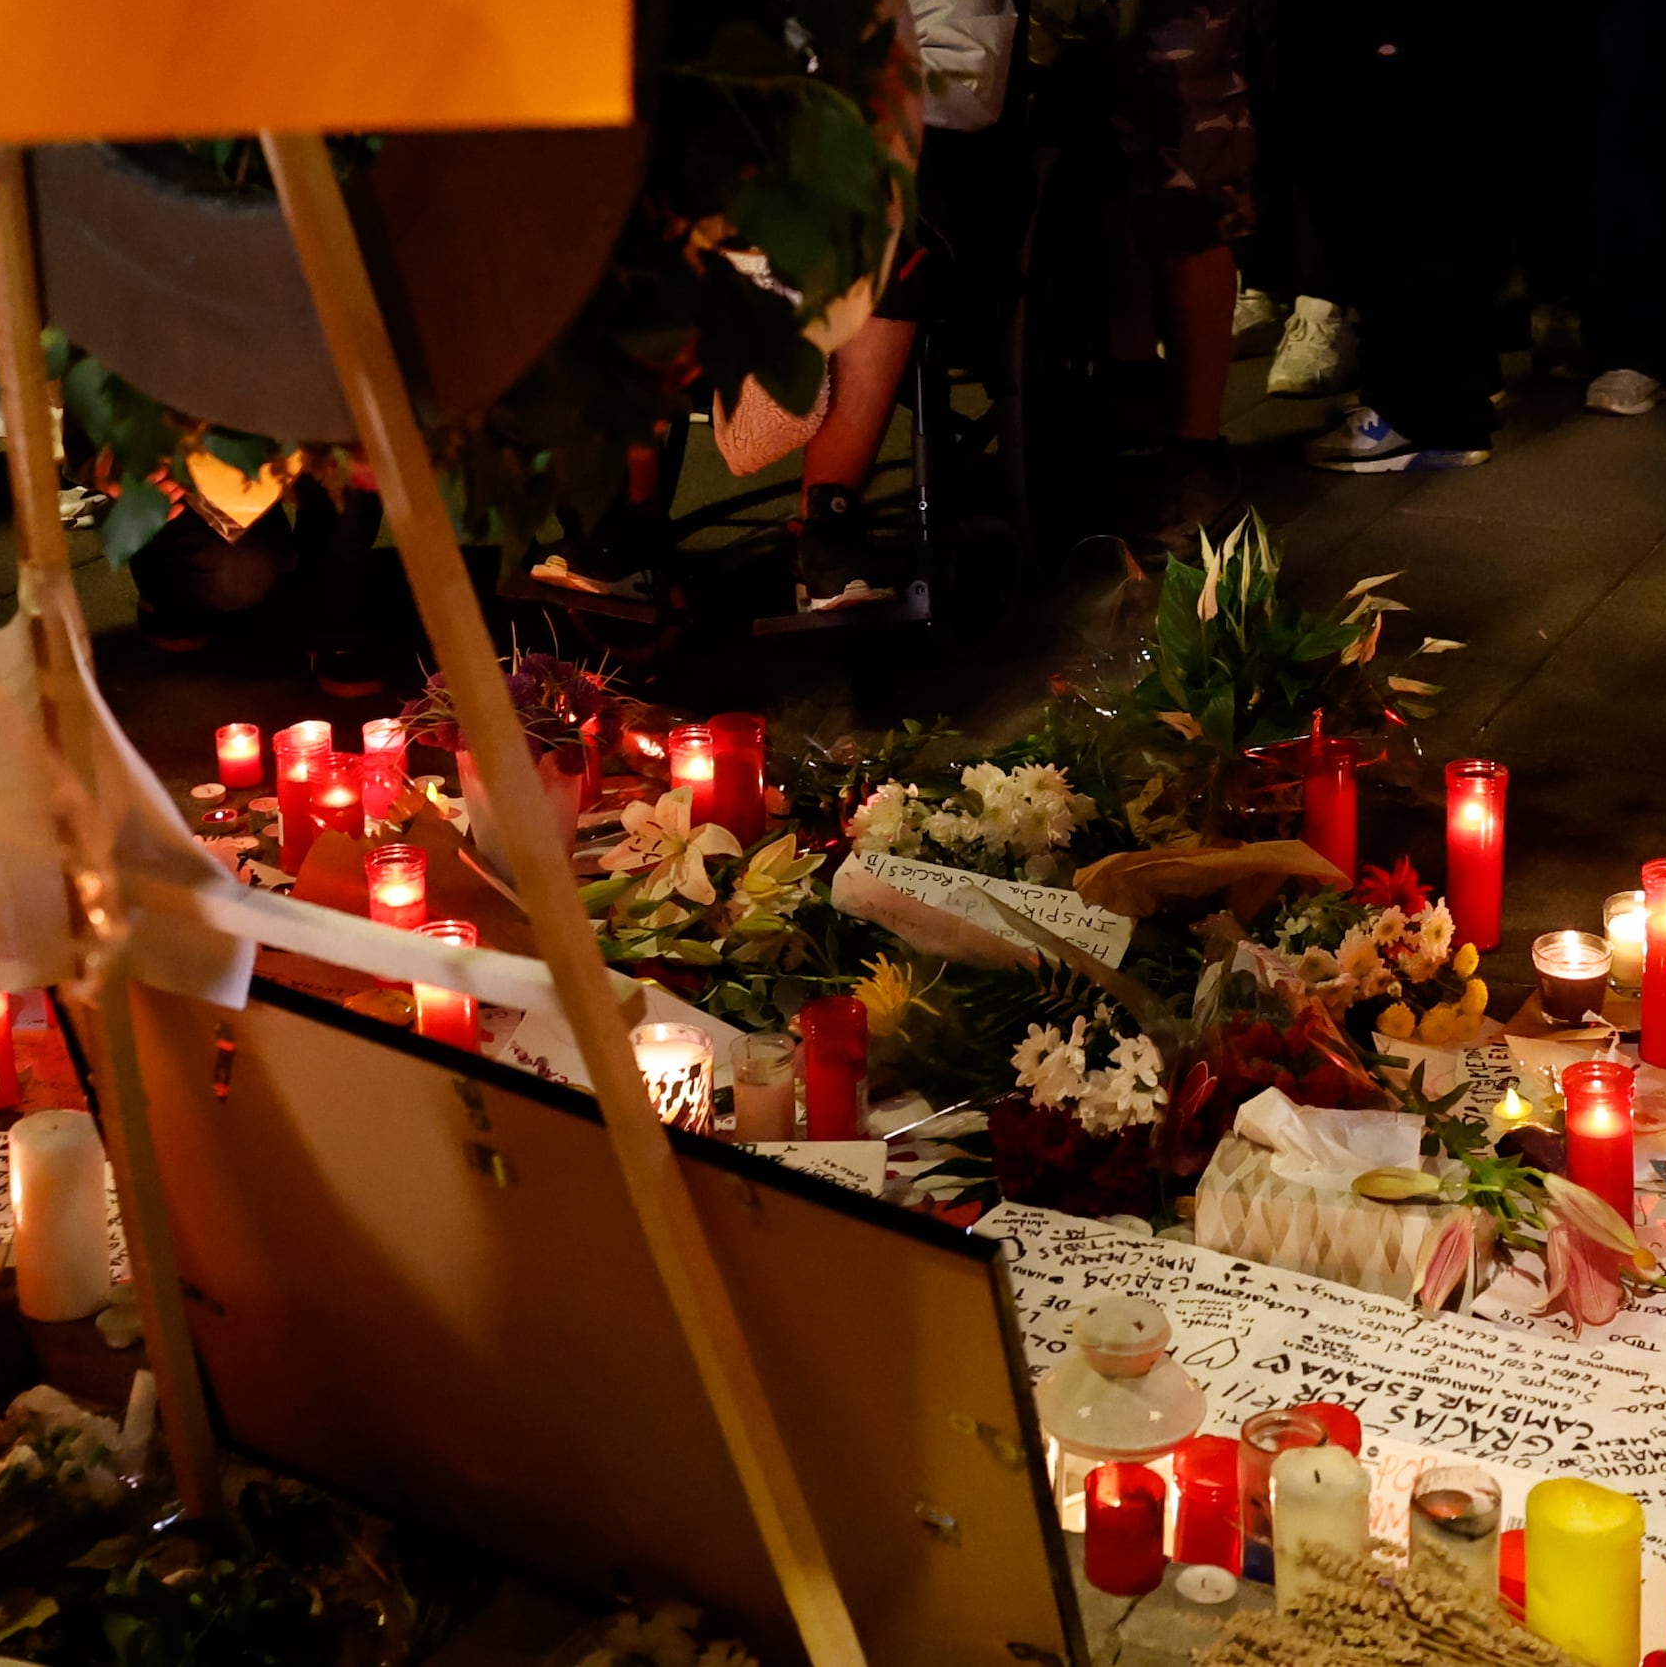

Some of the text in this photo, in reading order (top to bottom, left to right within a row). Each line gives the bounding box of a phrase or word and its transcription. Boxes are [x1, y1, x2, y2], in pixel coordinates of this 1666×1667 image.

[1608, 1334, 1661, 1353] TODO
[1300, 1361, 1425, 1402] ESPAÑA
[1383, 1404, 1555, 1458] GRACIAS
[1436, 1392, 1594, 1440] CAMBIAR
